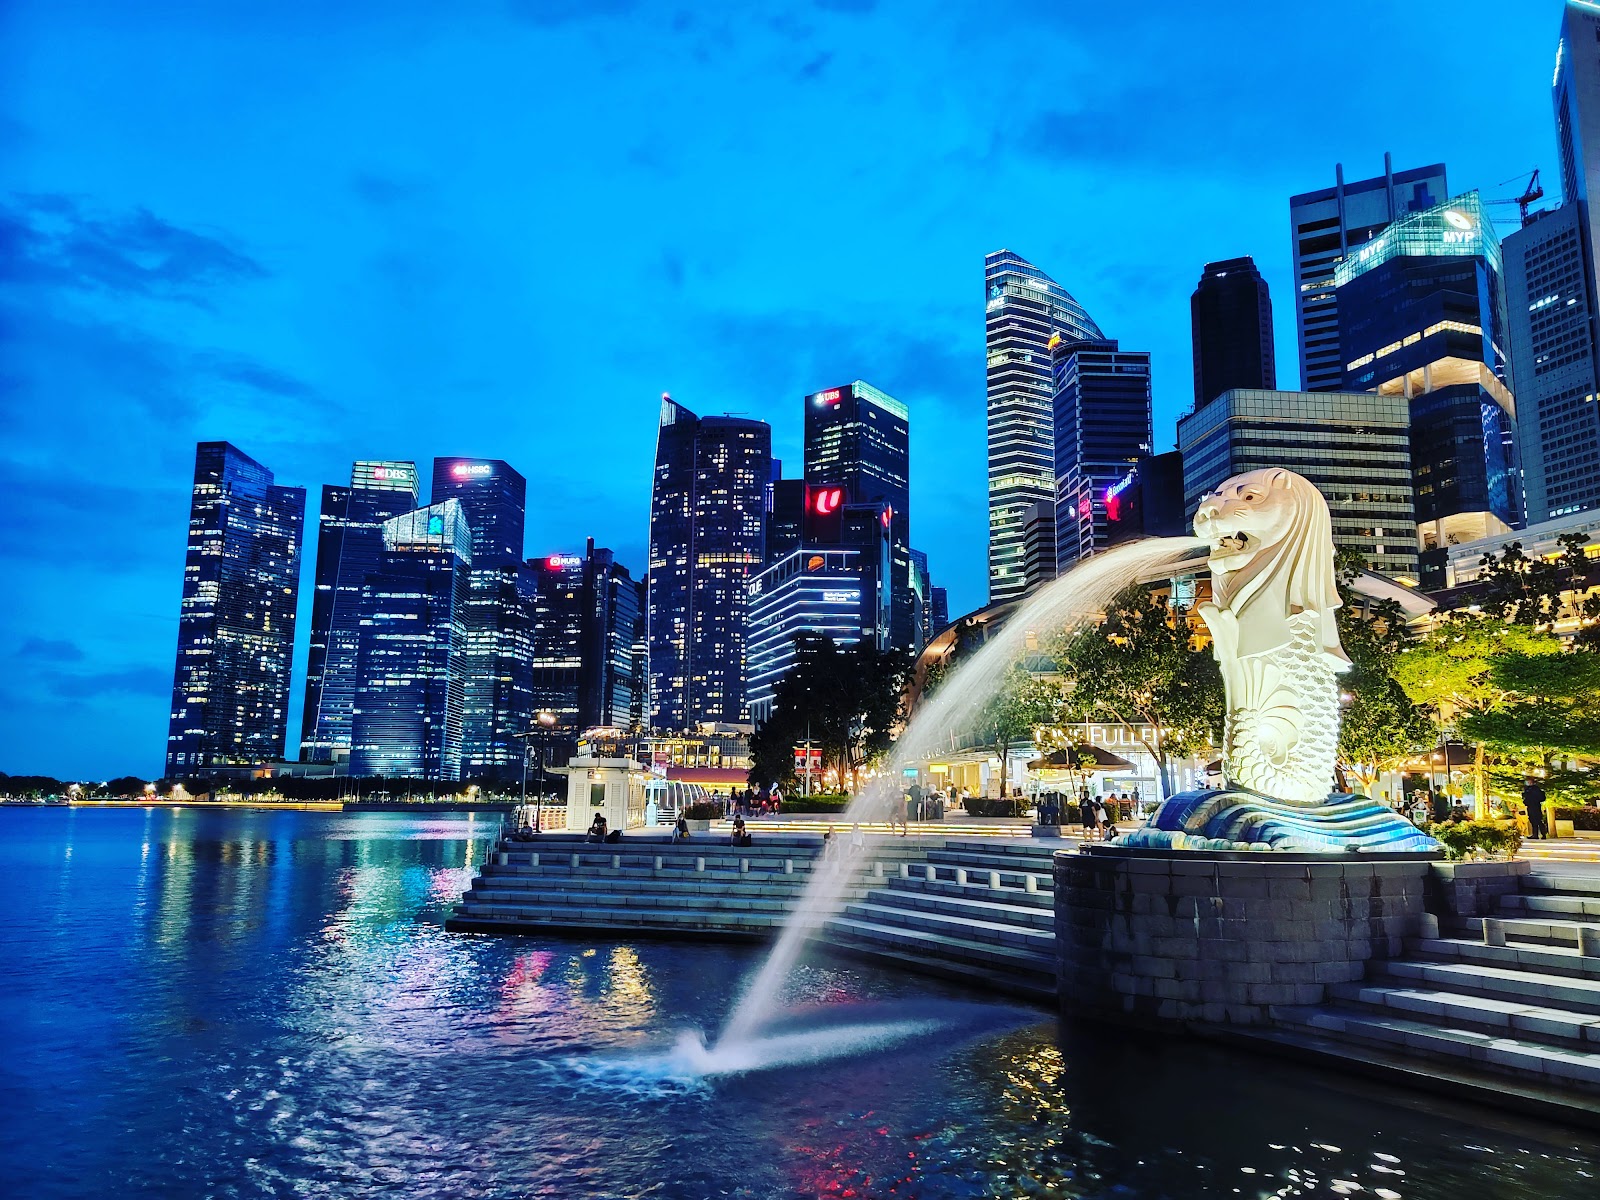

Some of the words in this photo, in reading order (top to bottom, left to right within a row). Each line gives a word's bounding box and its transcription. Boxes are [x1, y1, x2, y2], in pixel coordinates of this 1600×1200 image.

[1443, 231, 1475, 243] MYP
[1359, 239, 1385, 262] MYP
[824, 390, 840, 401] UBS
[384, 468, 407, 480] DBS
[467, 464, 490, 474] HSBC
[748, 579, 762, 596] OUE
